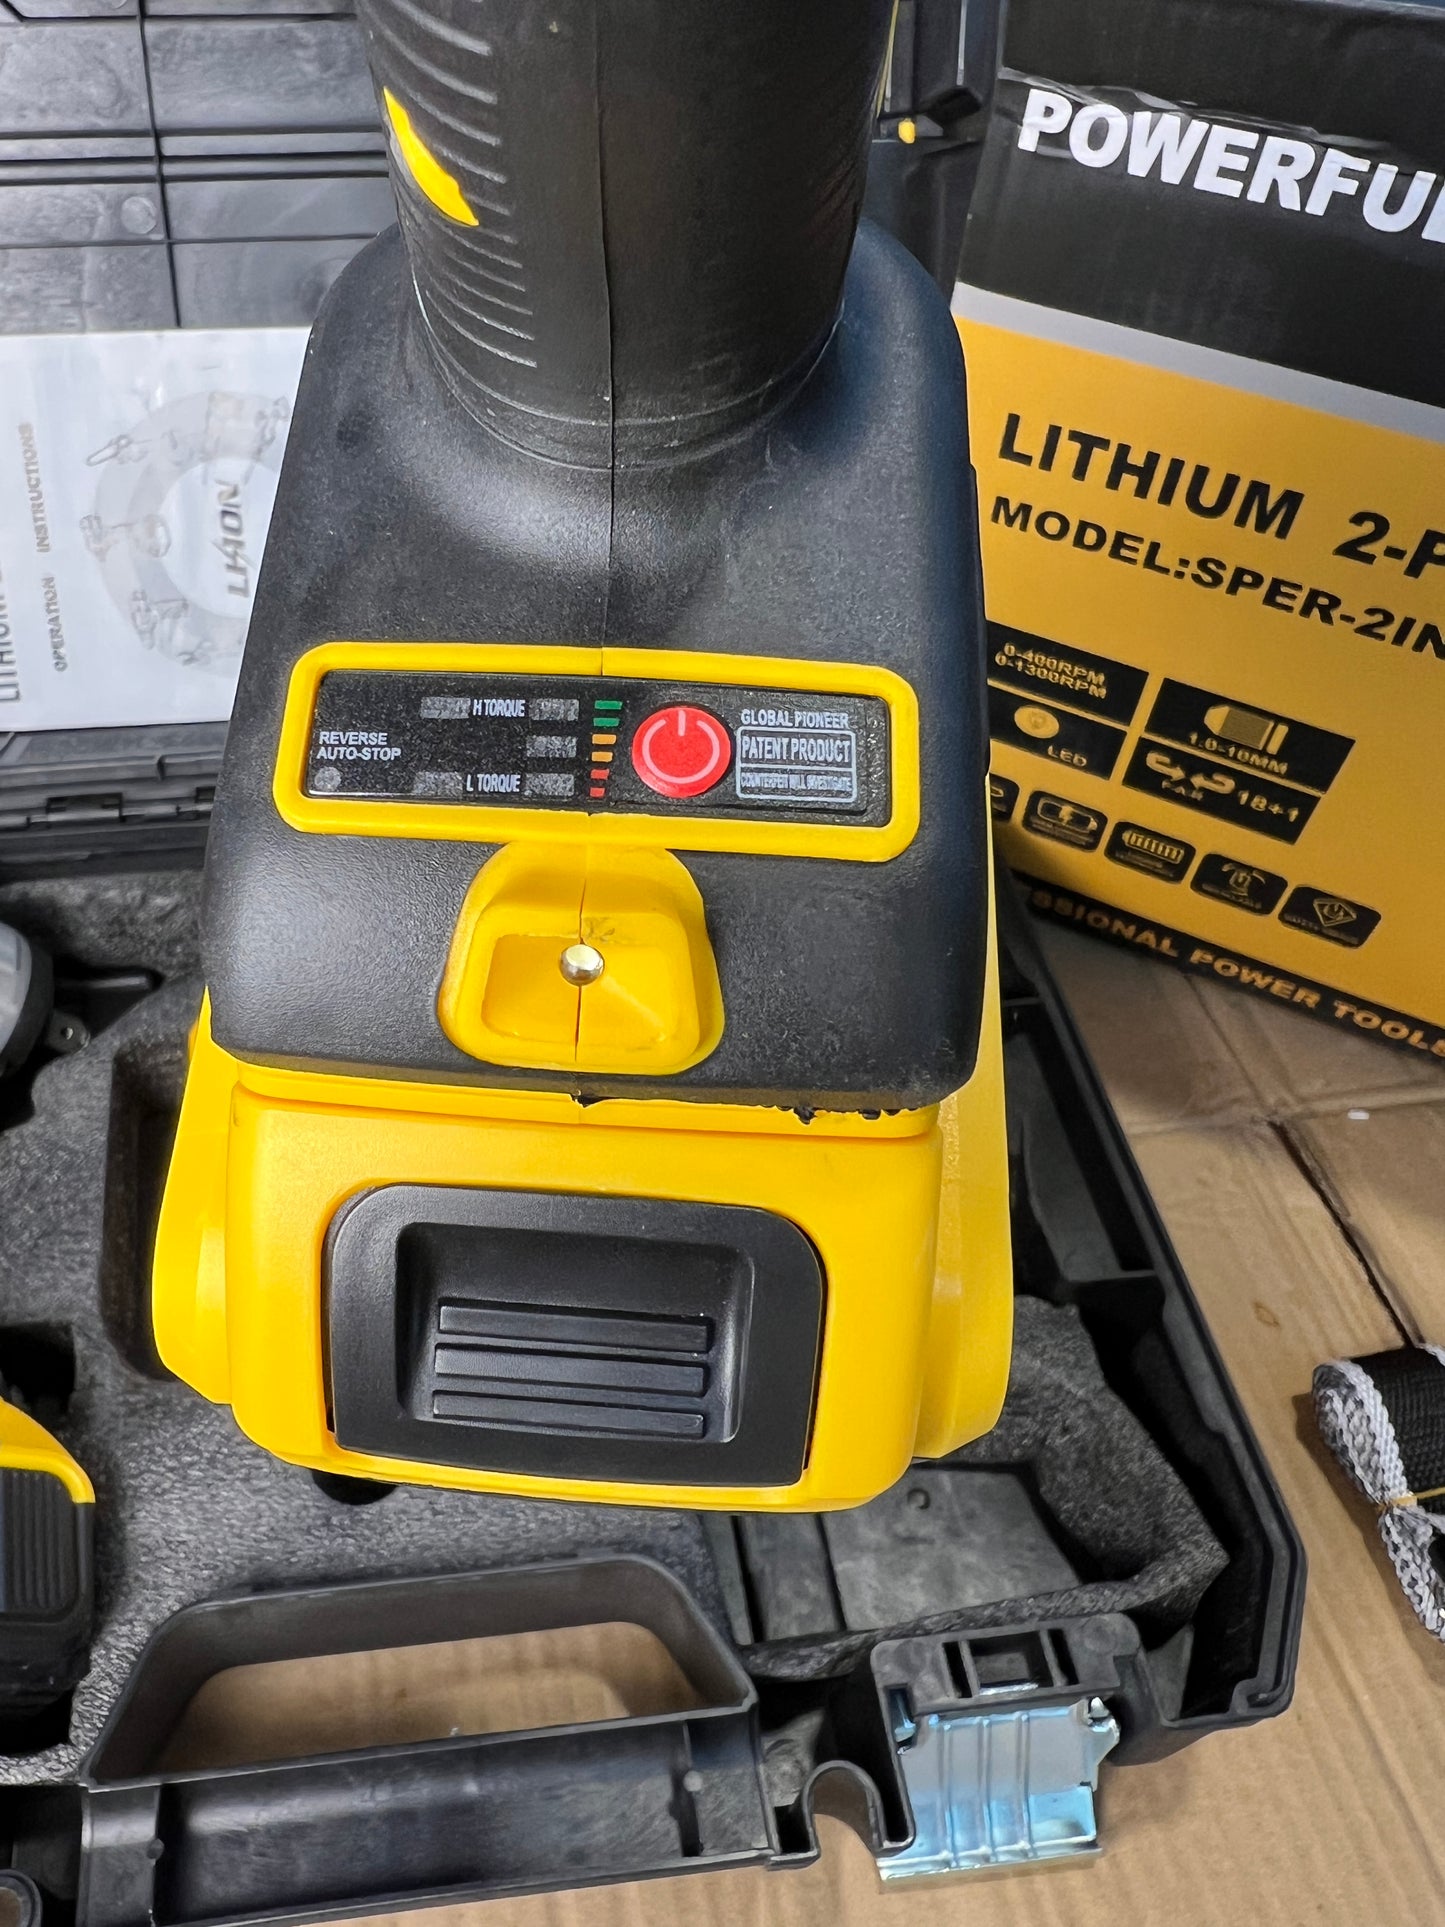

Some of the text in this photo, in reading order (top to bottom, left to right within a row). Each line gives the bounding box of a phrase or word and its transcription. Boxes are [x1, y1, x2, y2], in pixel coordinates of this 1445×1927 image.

[998, 412, 1305, 540] LITHIUM
[18, 422, 68, 673] OPERATION INSTRUCTIONS
[472, 698, 526, 718] H TORQUE
[740, 708, 850, 729] GLOBAL PIONEER
[318, 731, 388, 746] REVERSE
[741, 735, 851, 763] PATENT PRODUCT
[316, 747, 402, 761] AUTO-STOP
[1047, 744, 1088, 767] LED
[466, 773, 521, 793] L TORQUE
[1238, 788, 1300, 823] 18+1
[1189, 948, 1322, 1009] POWER
